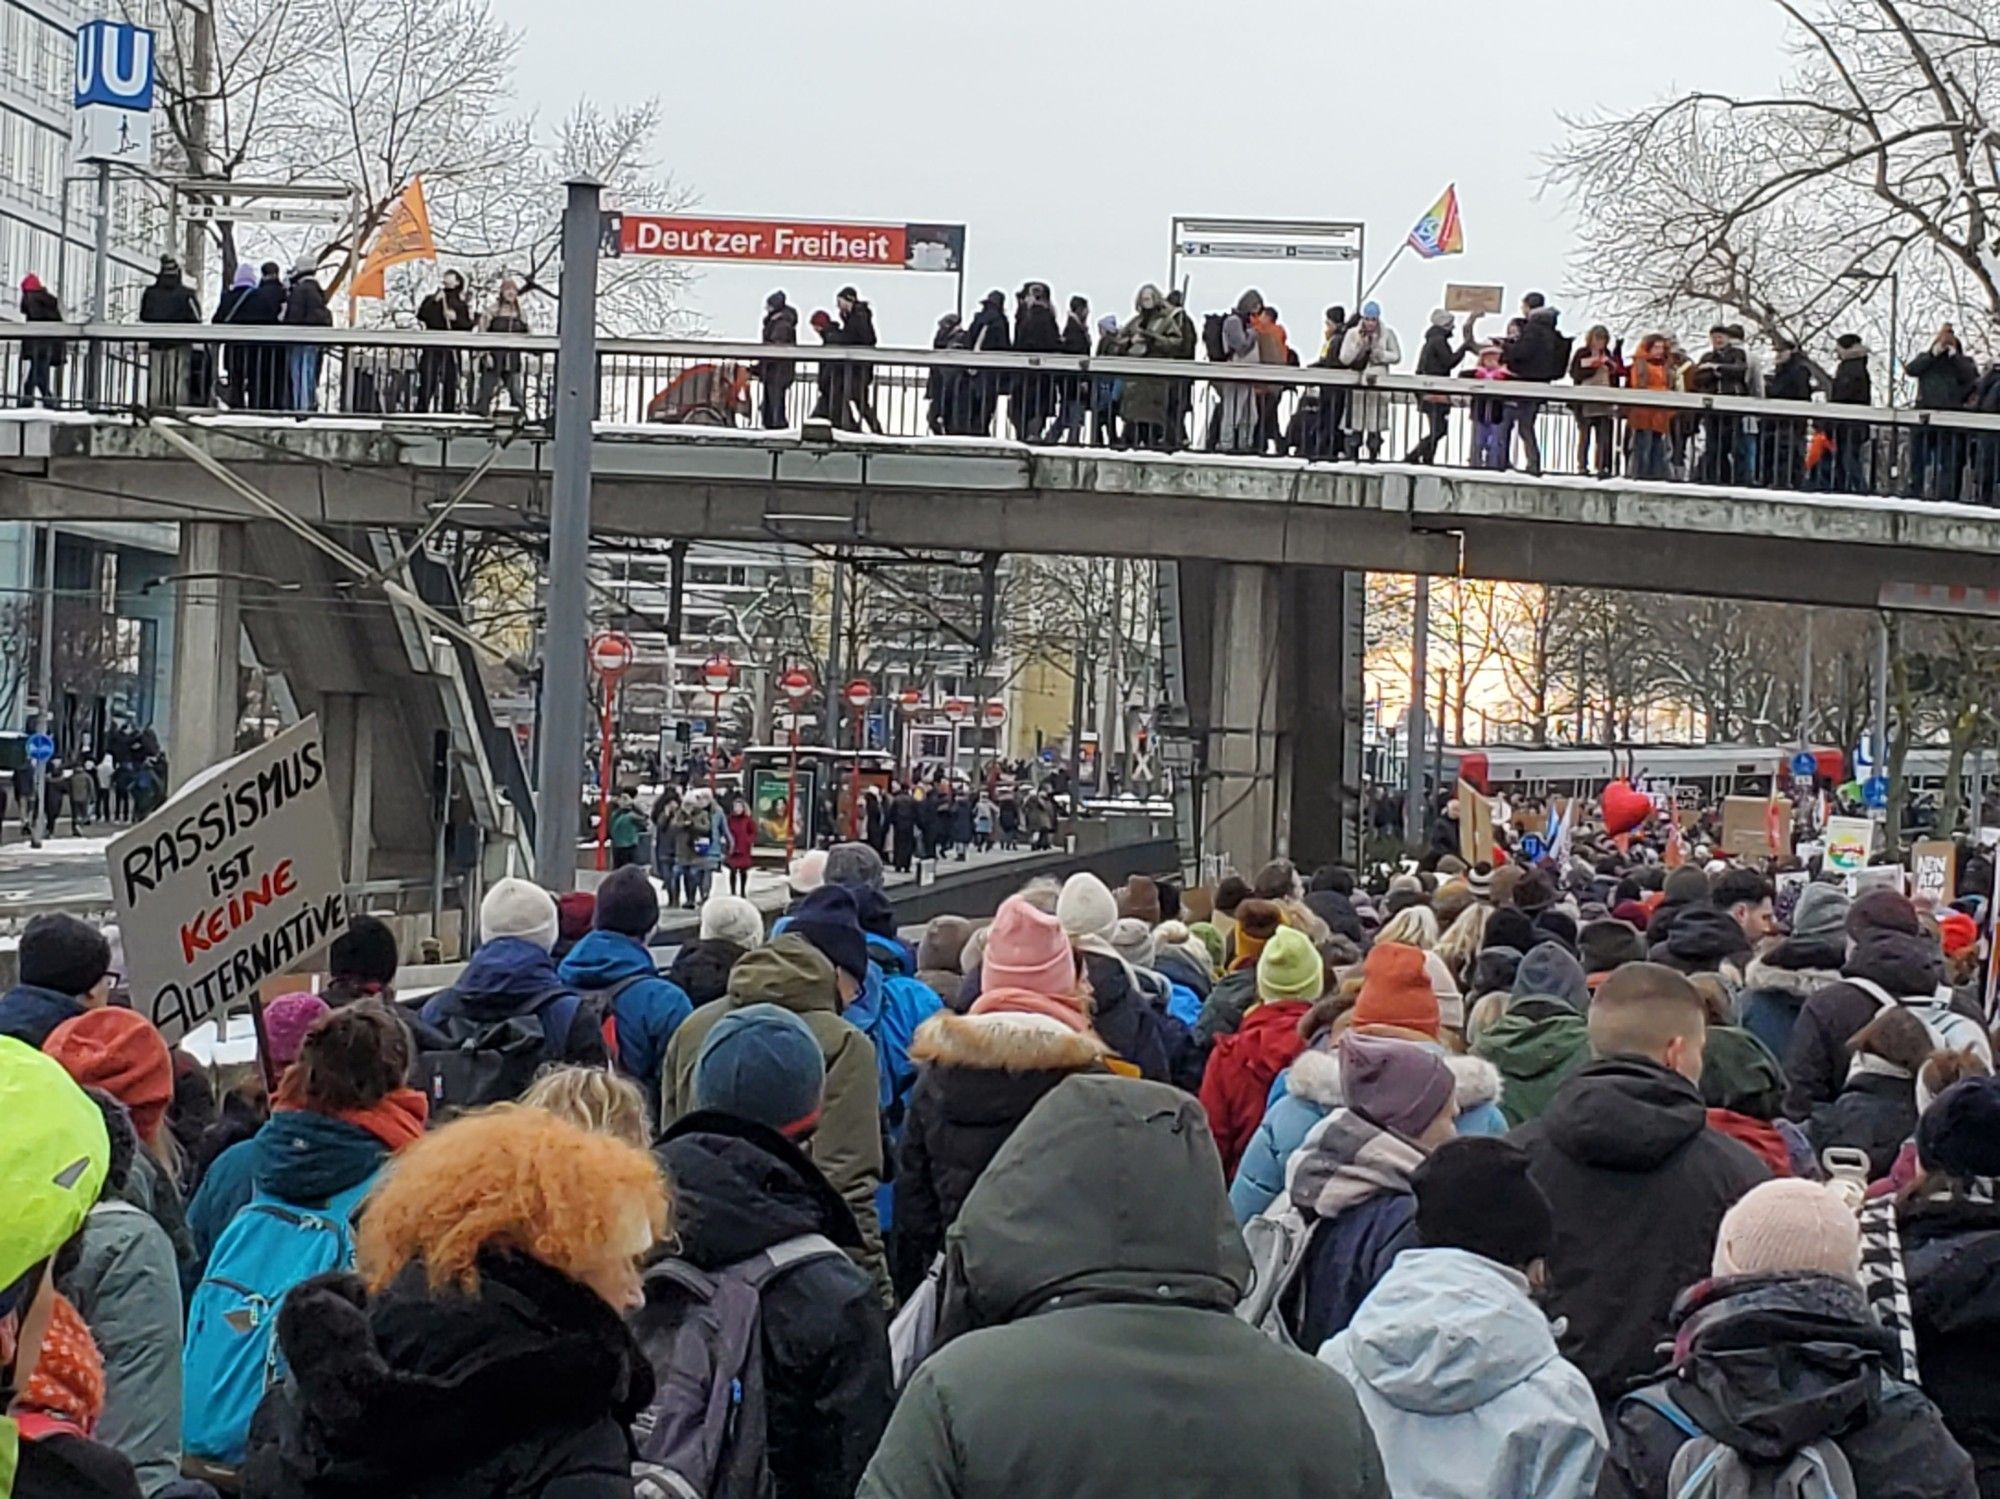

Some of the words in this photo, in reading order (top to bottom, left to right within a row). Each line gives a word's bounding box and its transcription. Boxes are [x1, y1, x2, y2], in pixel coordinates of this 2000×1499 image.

[102, 25, 149, 96] U
[637, 221, 762, 253] Deutzer
[774, 228, 889, 261] Freiheit
